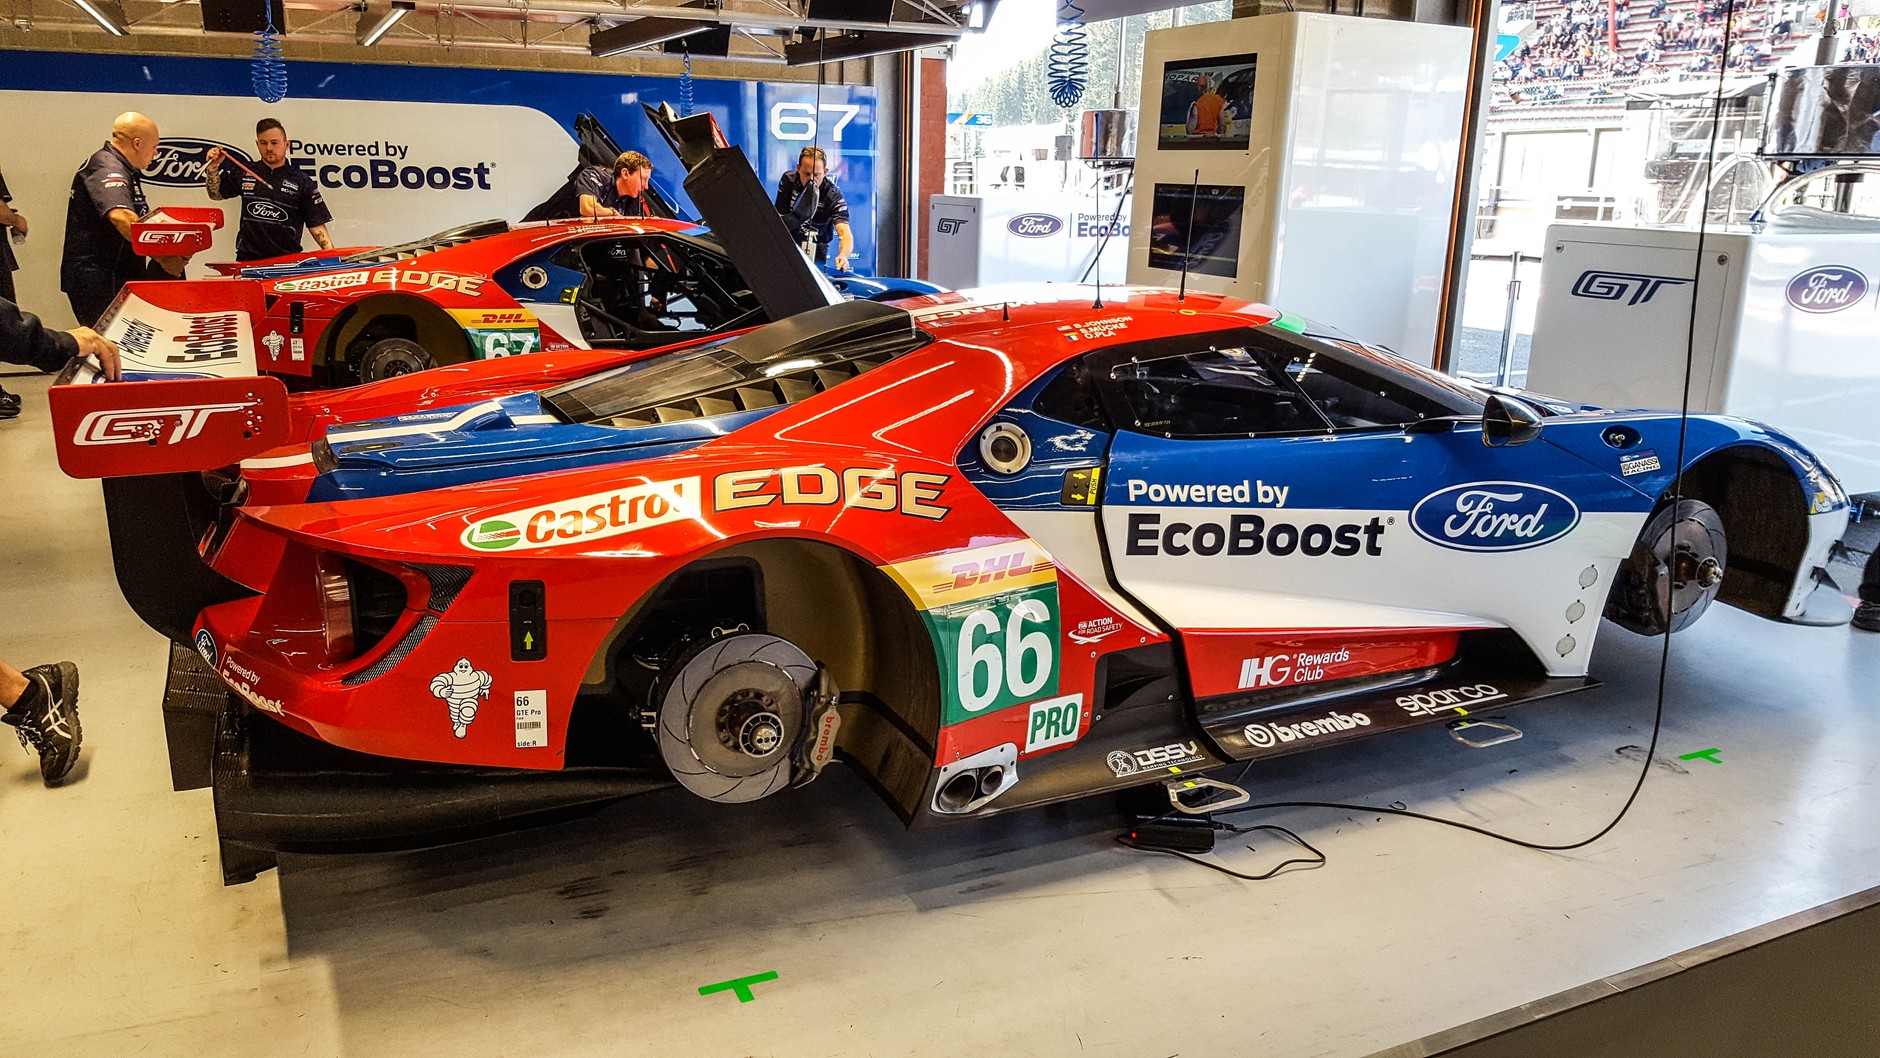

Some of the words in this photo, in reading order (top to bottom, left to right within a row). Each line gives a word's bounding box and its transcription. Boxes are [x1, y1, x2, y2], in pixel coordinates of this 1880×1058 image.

[771, 102, 860, 142] 67
[289, 140, 379, 157] Powered
[385, 141, 408, 160] by
[253, 203, 280, 218] Ford
[1078, 213, 1116, 221] Powered
[1117, 213, 1127, 223] by
[937, 218, 969, 236] GT
[1018, 216, 1053, 235] Ford
[299, 273, 363, 291] Castrol
[372, 270, 485, 297] EDGE
[1571, 270, 1695, 306] GT
[1801, 273, 1852, 305] Ford
[481, 313, 526, 324] DHL
[1084, 331, 1116, 340] O.PLA
[73, 401, 259, 445] GT
[1623, 464, 1660, 475] RACING
[713, 466, 952, 522] EDGE
[1089, 478, 1098, 495] PUSH
[1128, 479, 1250, 503] Powered
[1257, 480, 1289, 508] by
[525, 484, 684, 545] Castrol
[1444, 490, 1549, 538] Ford
[951, 552, 1034, 590] DHL
[1086, 627, 1102, 635] ROAD
[1102, 623, 1123, 632] SAFETY
[1088, 617, 1113, 628] ACTION
[957, 599, 1053, 712] 66
[1238, 654, 1292, 690] IHG
[1297, 648, 1350, 668] Rewards
[226, 655, 252, 681] Powered
[251, 669, 261, 686] by
[1294, 668, 1325, 684] Club
[516, 696, 530, 707] 66
[516, 709, 529, 717] GTE
[530, 708, 542, 716] Pro
[1395, 684, 1500, 716] sparco
[1029, 702, 1079, 745] PRO
[1270, 711, 1372, 743] brembo
[816, 716, 836, 762] brembo
[1133, 740, 1199, 767] DSSV
[1167, 754, 1203, 767] TECHNOLOGY
